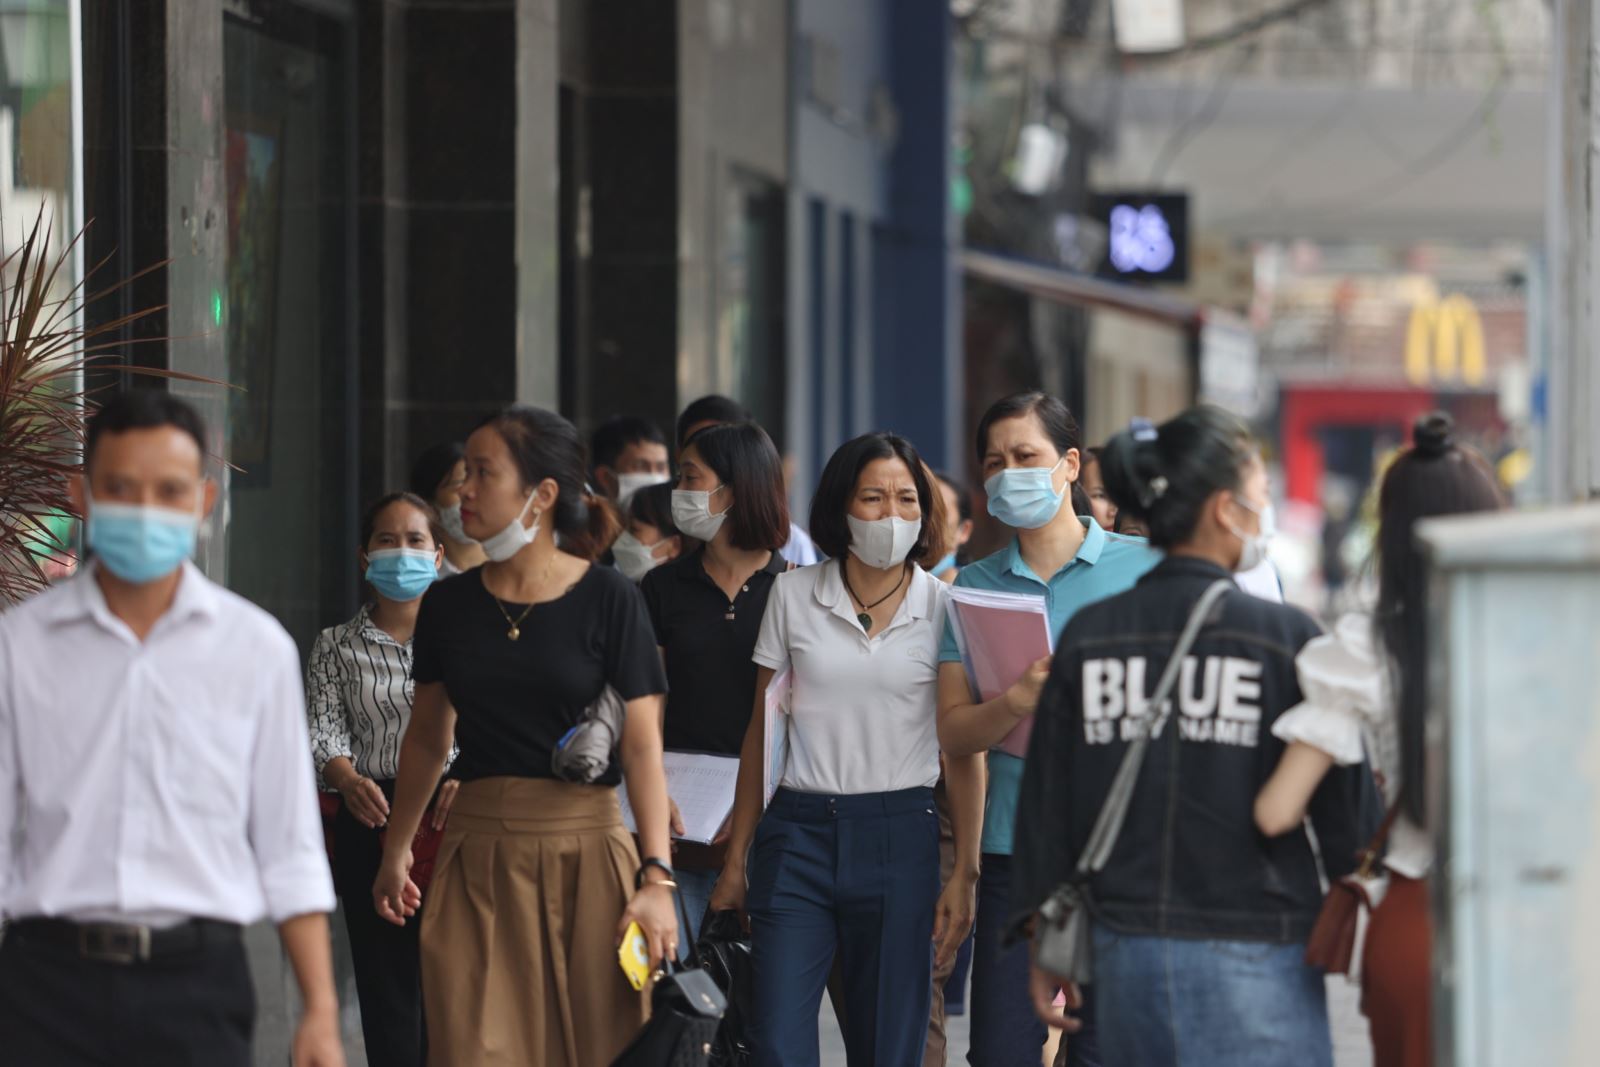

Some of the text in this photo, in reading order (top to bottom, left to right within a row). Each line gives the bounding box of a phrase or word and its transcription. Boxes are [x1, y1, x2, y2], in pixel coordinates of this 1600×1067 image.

[1082, 656, 1262, 720] BLUE
[1084, 718, 1115, 745] IS
[1177, 716, 1260, 748] NAME
